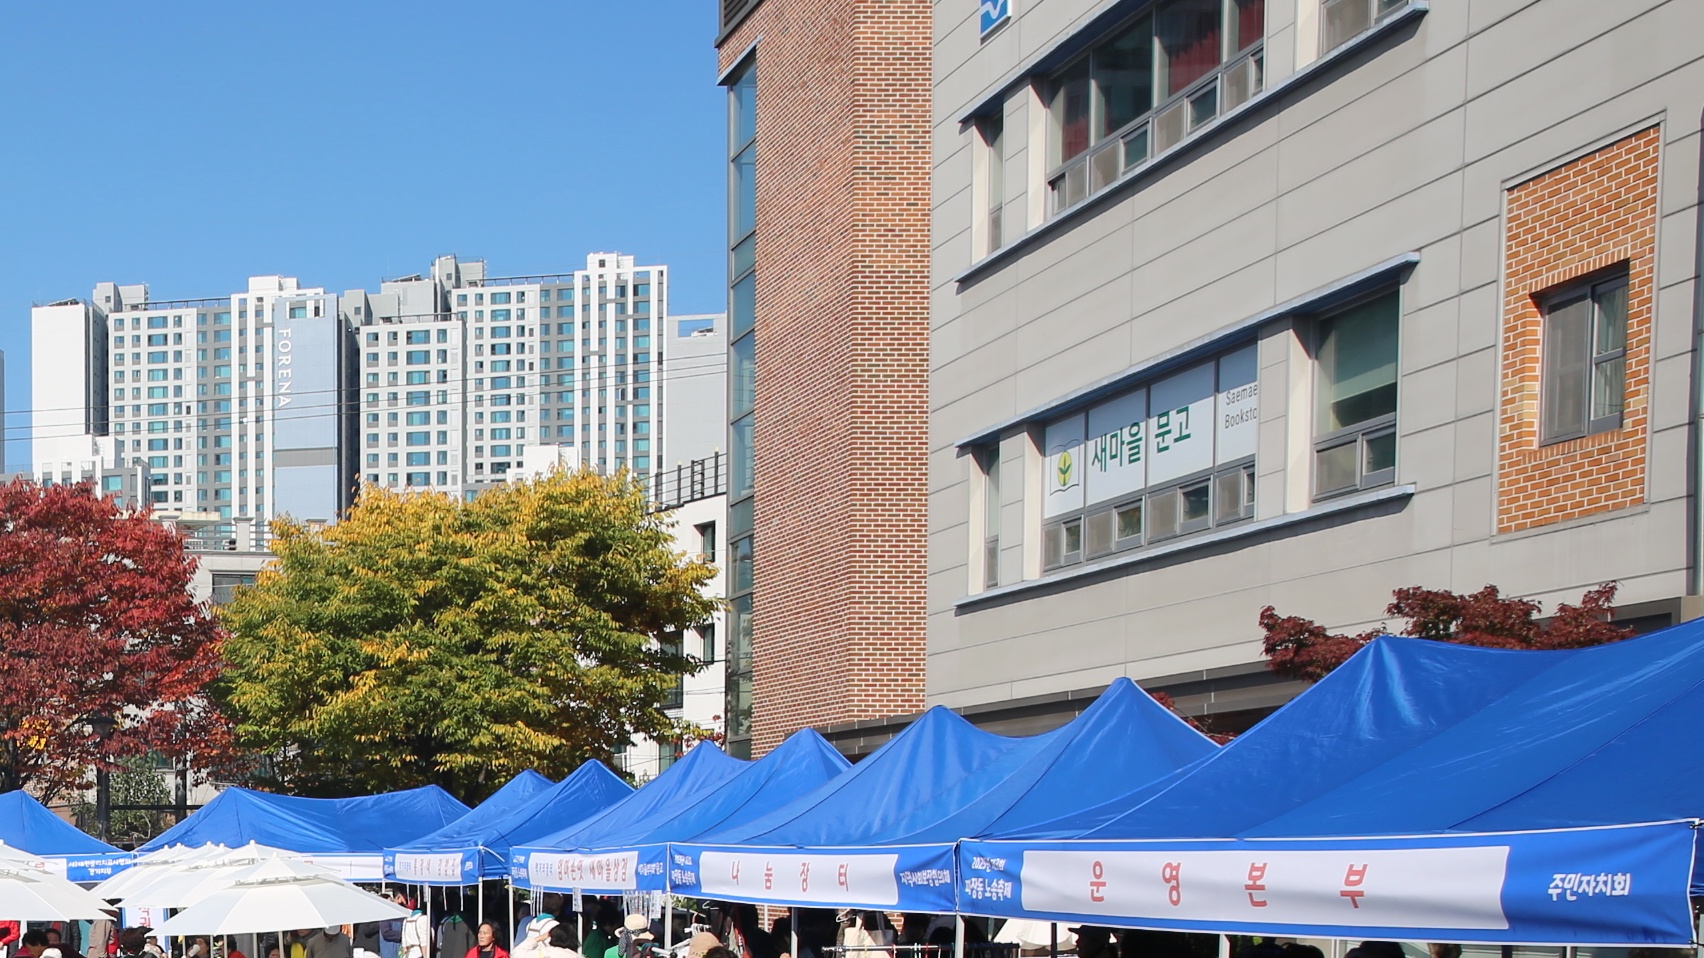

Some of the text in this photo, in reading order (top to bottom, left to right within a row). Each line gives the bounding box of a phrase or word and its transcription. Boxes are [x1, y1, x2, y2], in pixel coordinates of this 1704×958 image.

[278, 328, 291, 407] FORENA
[1226, 384, 1258, 406] Saemae
[1091, 406, 1192, 473] 새마을 문고
[964, 878, 1013, 902] 파장동 노송축제
[1547, 872, 1631, 902] 주민자치회
